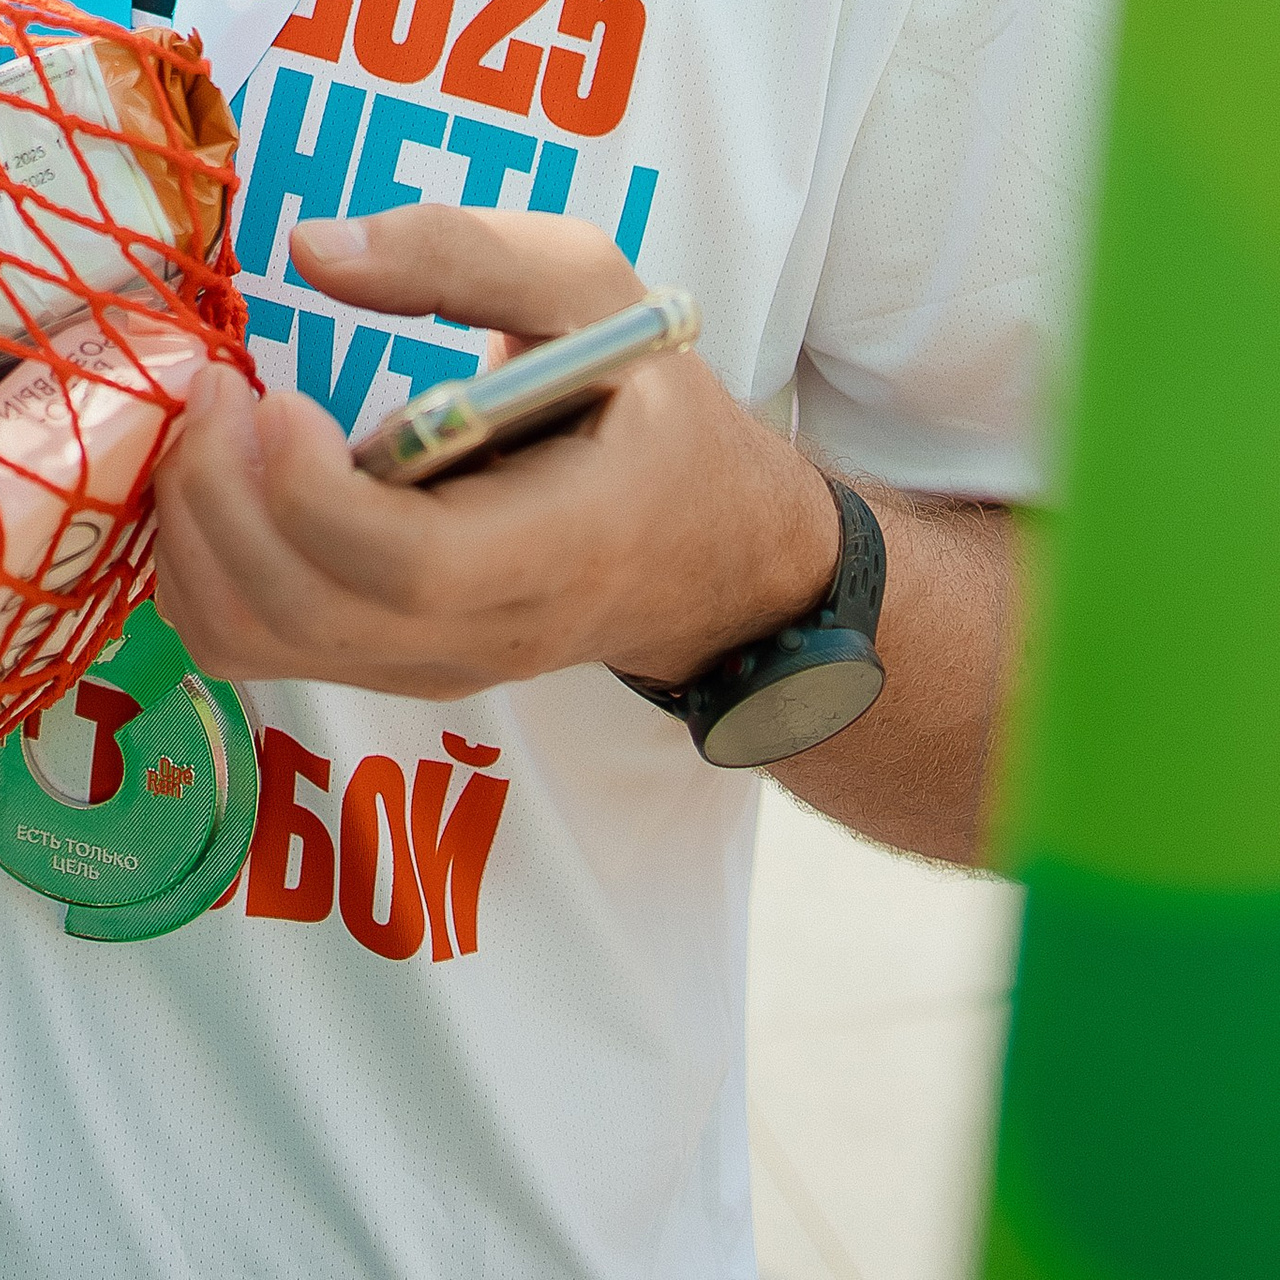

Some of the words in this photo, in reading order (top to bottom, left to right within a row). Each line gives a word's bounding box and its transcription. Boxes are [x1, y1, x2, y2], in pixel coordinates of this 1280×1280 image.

[16, 824, 62, 851] ЕСТЬ
[65, 838, 139, 871] ТОЛЬКО
[52, 854, 101, 880] ЦЕЛЬ
